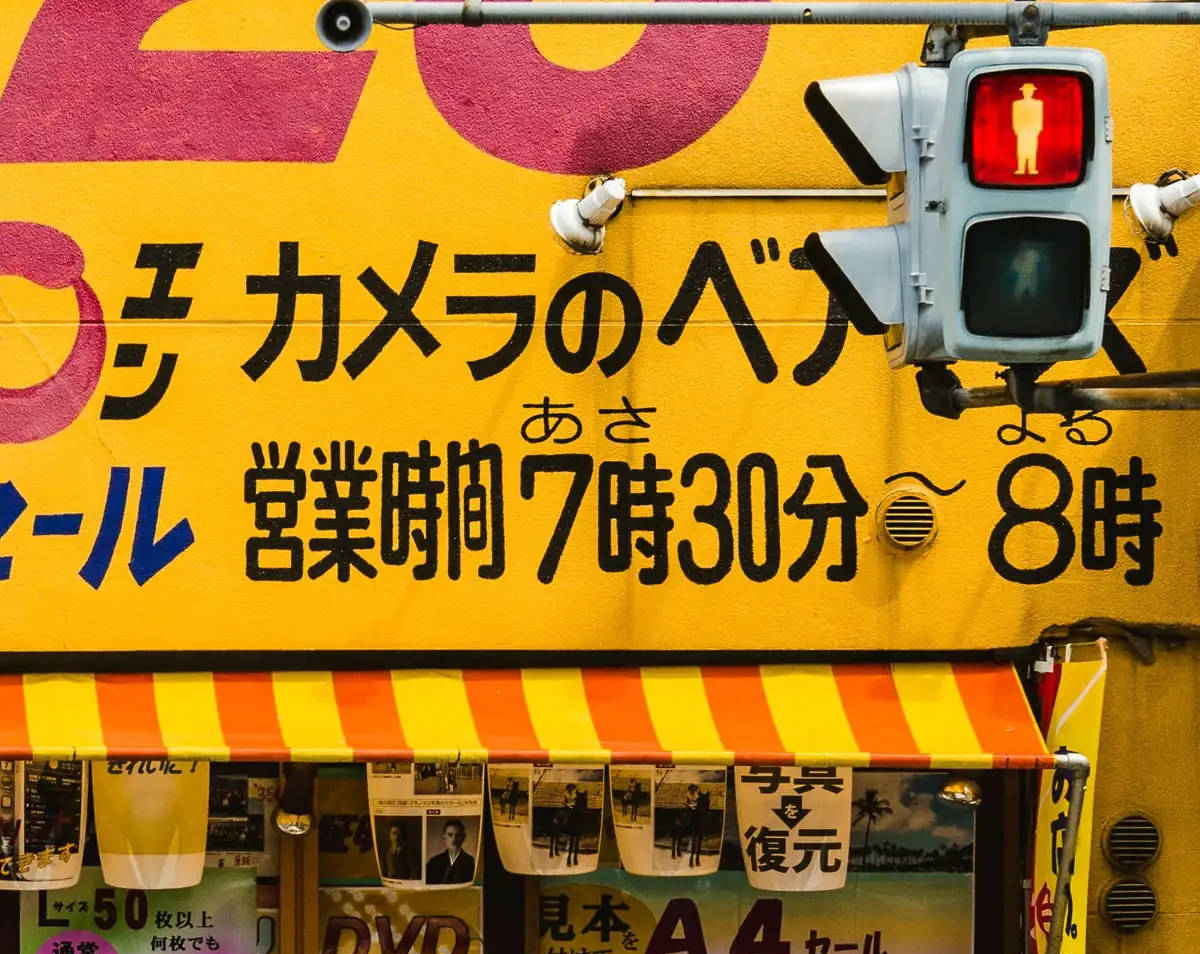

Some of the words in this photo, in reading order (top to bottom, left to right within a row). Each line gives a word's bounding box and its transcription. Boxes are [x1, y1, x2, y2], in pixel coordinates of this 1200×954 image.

[522, 397, 656, 444] あさ
[744, 825, 843, 874] 復元
[150, 936, 220, 952] 何枚でも
